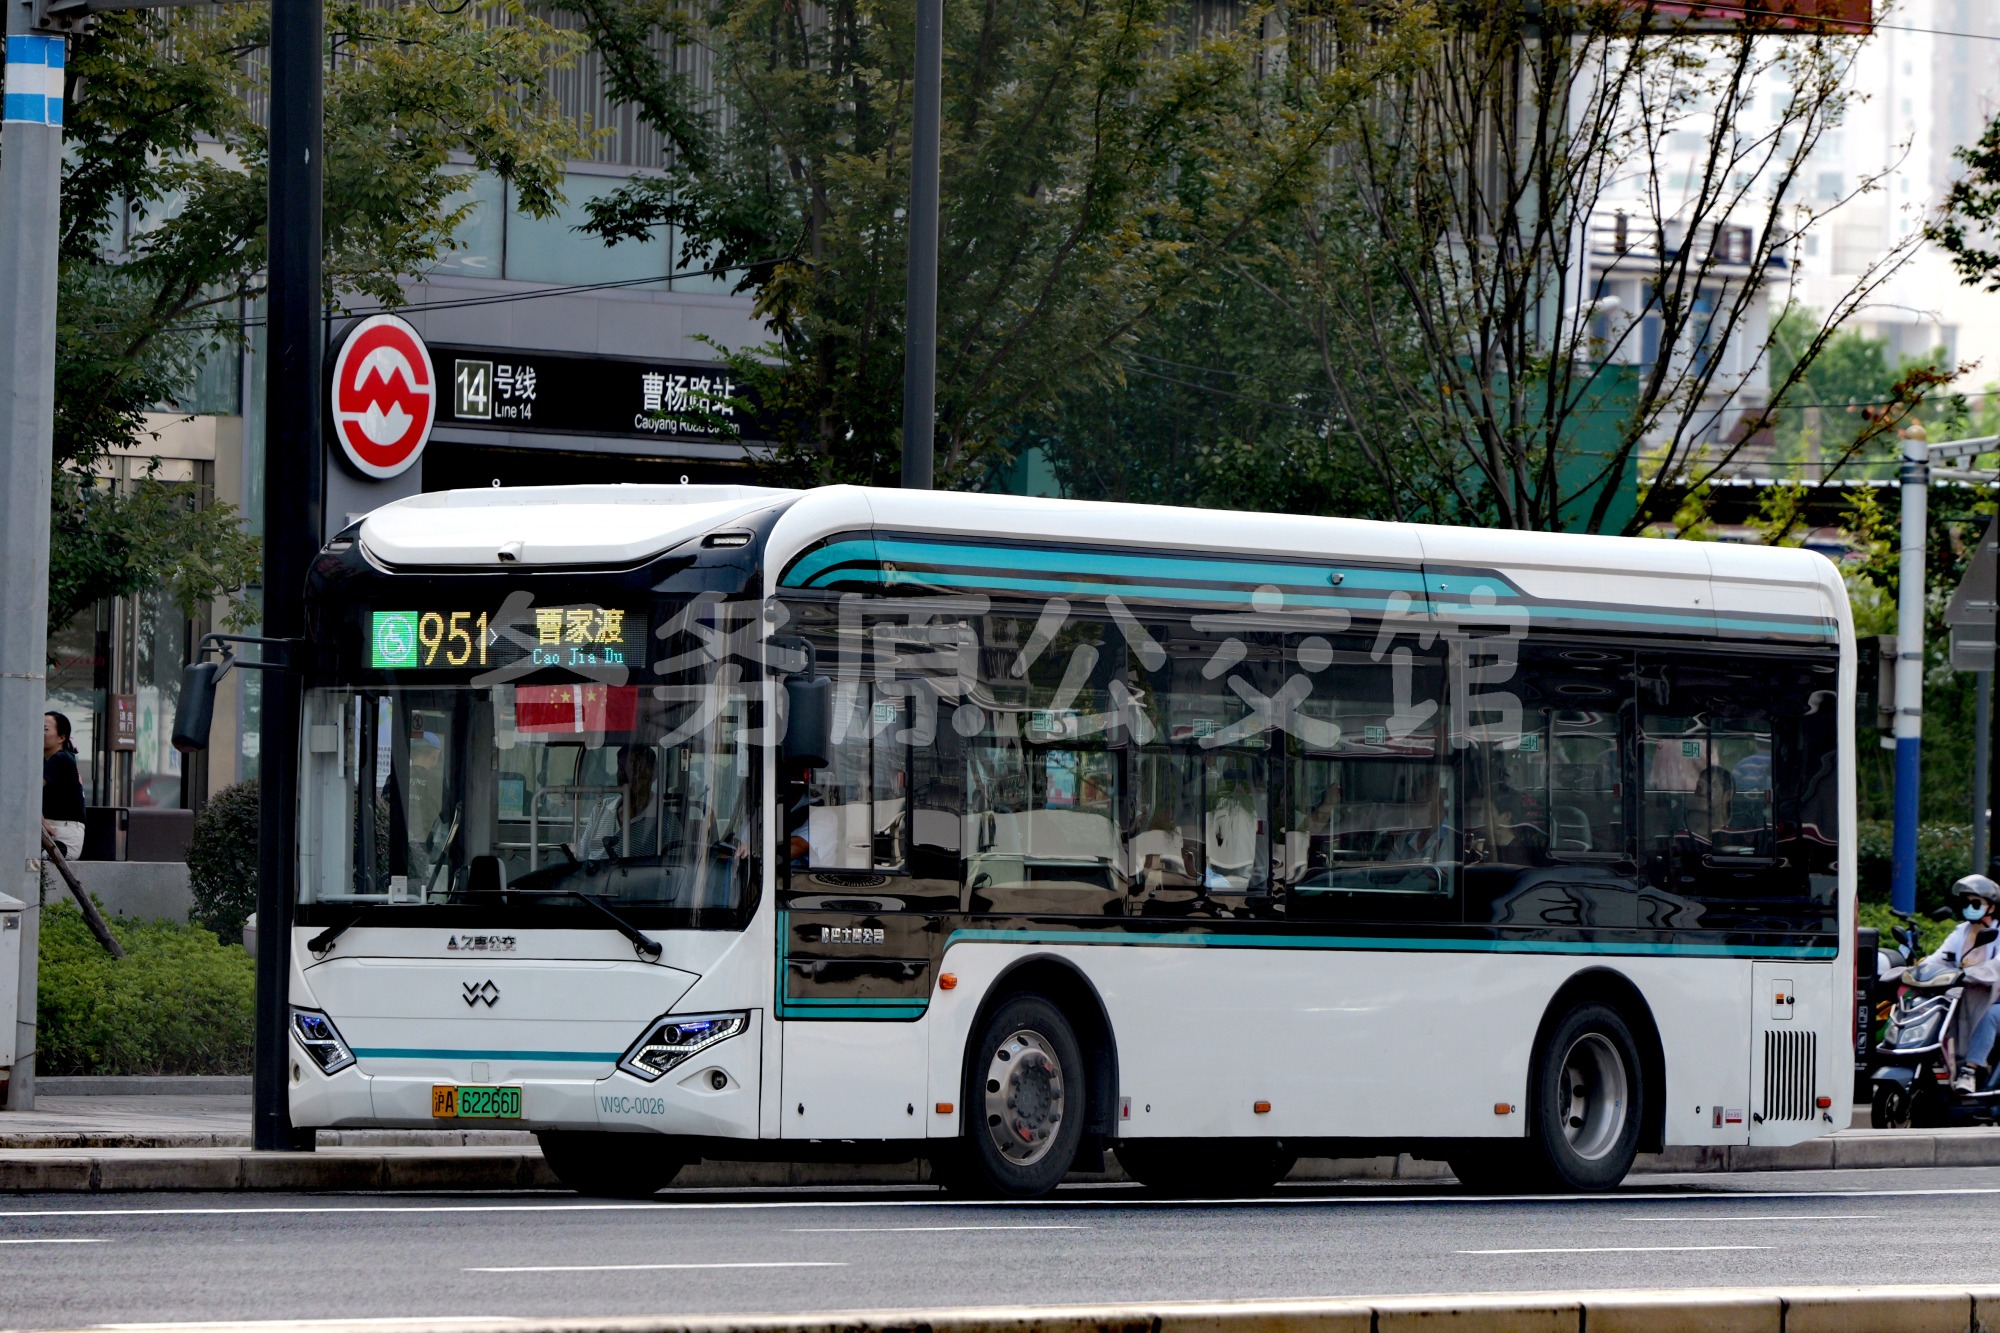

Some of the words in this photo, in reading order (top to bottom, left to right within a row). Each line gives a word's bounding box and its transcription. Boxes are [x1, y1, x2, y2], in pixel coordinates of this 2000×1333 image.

[457, 366, 488, 413] 14
[493, 365, 537, 400] 号线
[641, 371, 736, 416] 曹杨路站
[495, 401, 518, 418] Line
[519, 402, 532, 420] 14
[634, 413, 677, 435] Caoyang
[419, 611, 488, 666] 951
[535, 608, 625, 645] 曹家渡
[532, 649, 560, 665] Cao
[568, 649, 597, 666] Jia
[604, 648, 624, 664] Du
[600, 1096, 665, 1115] W9C-0026
